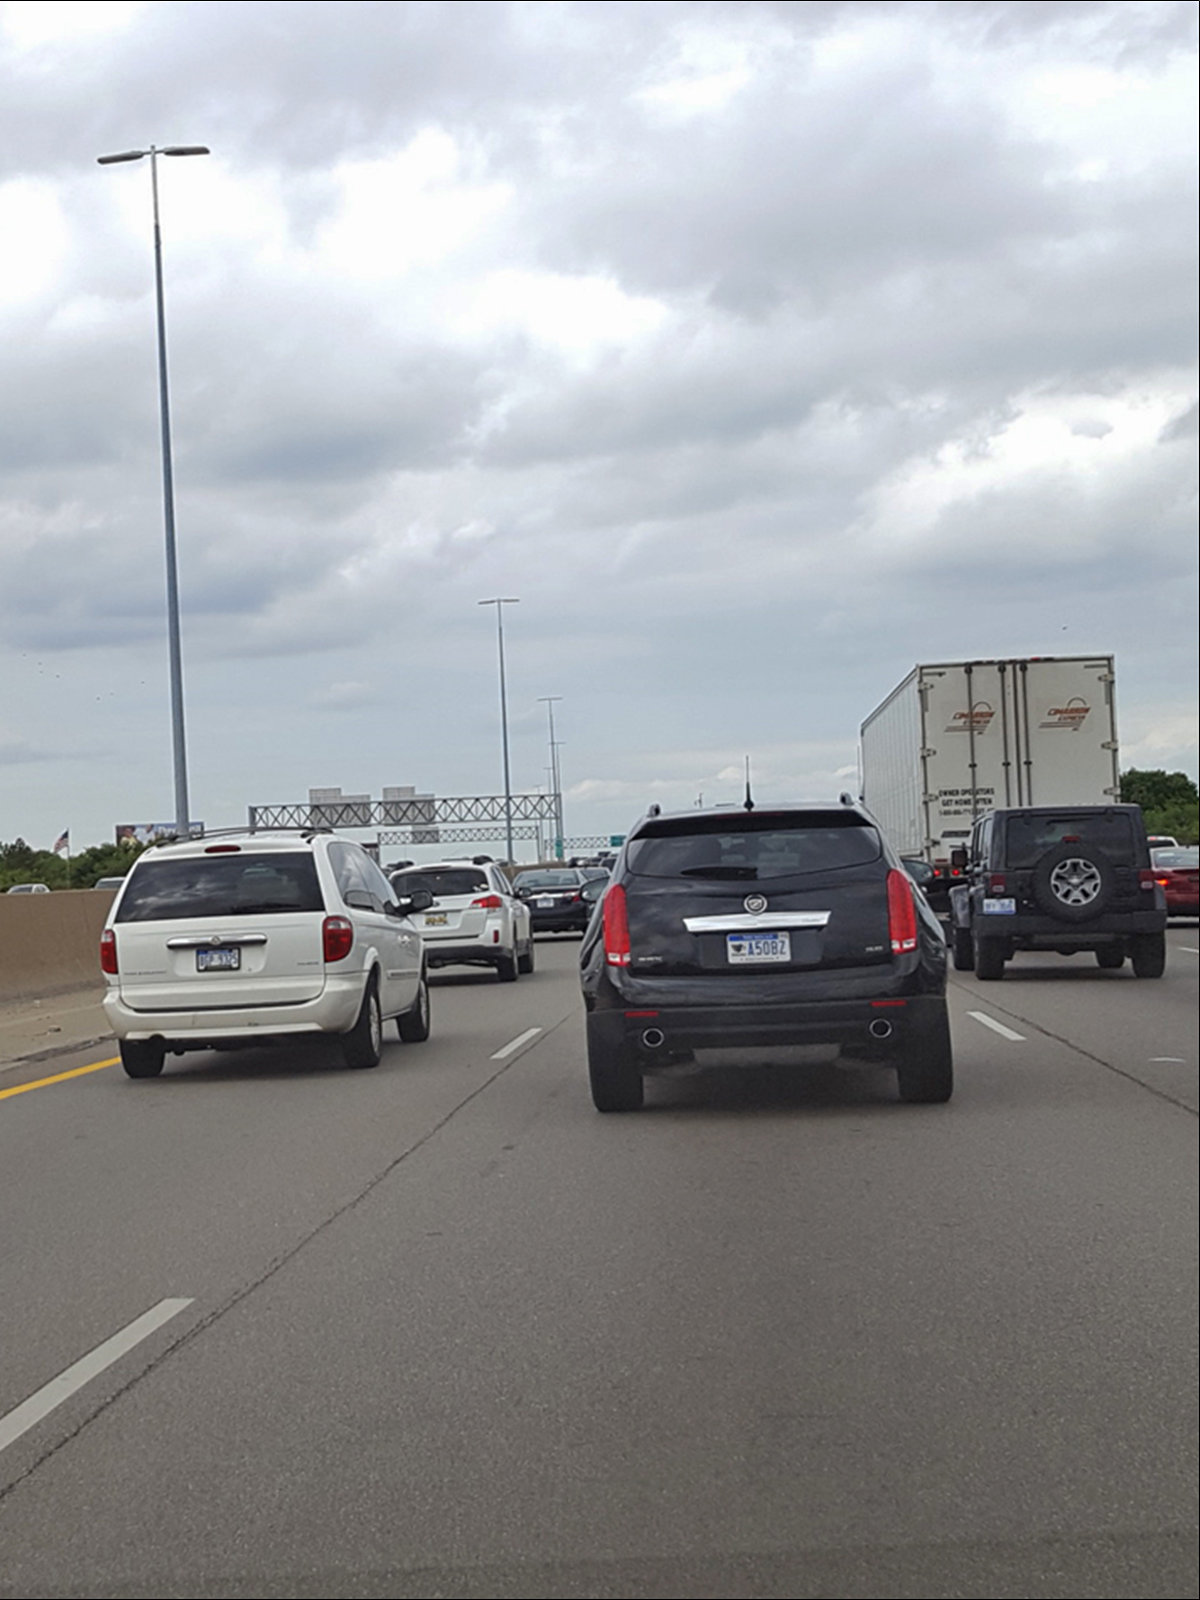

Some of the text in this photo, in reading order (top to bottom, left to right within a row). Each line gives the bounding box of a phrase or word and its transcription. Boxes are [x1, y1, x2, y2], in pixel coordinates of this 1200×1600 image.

[938, 788, 995, 797] OWNER OPEATORS
[942, 799, 953, 807] GET
